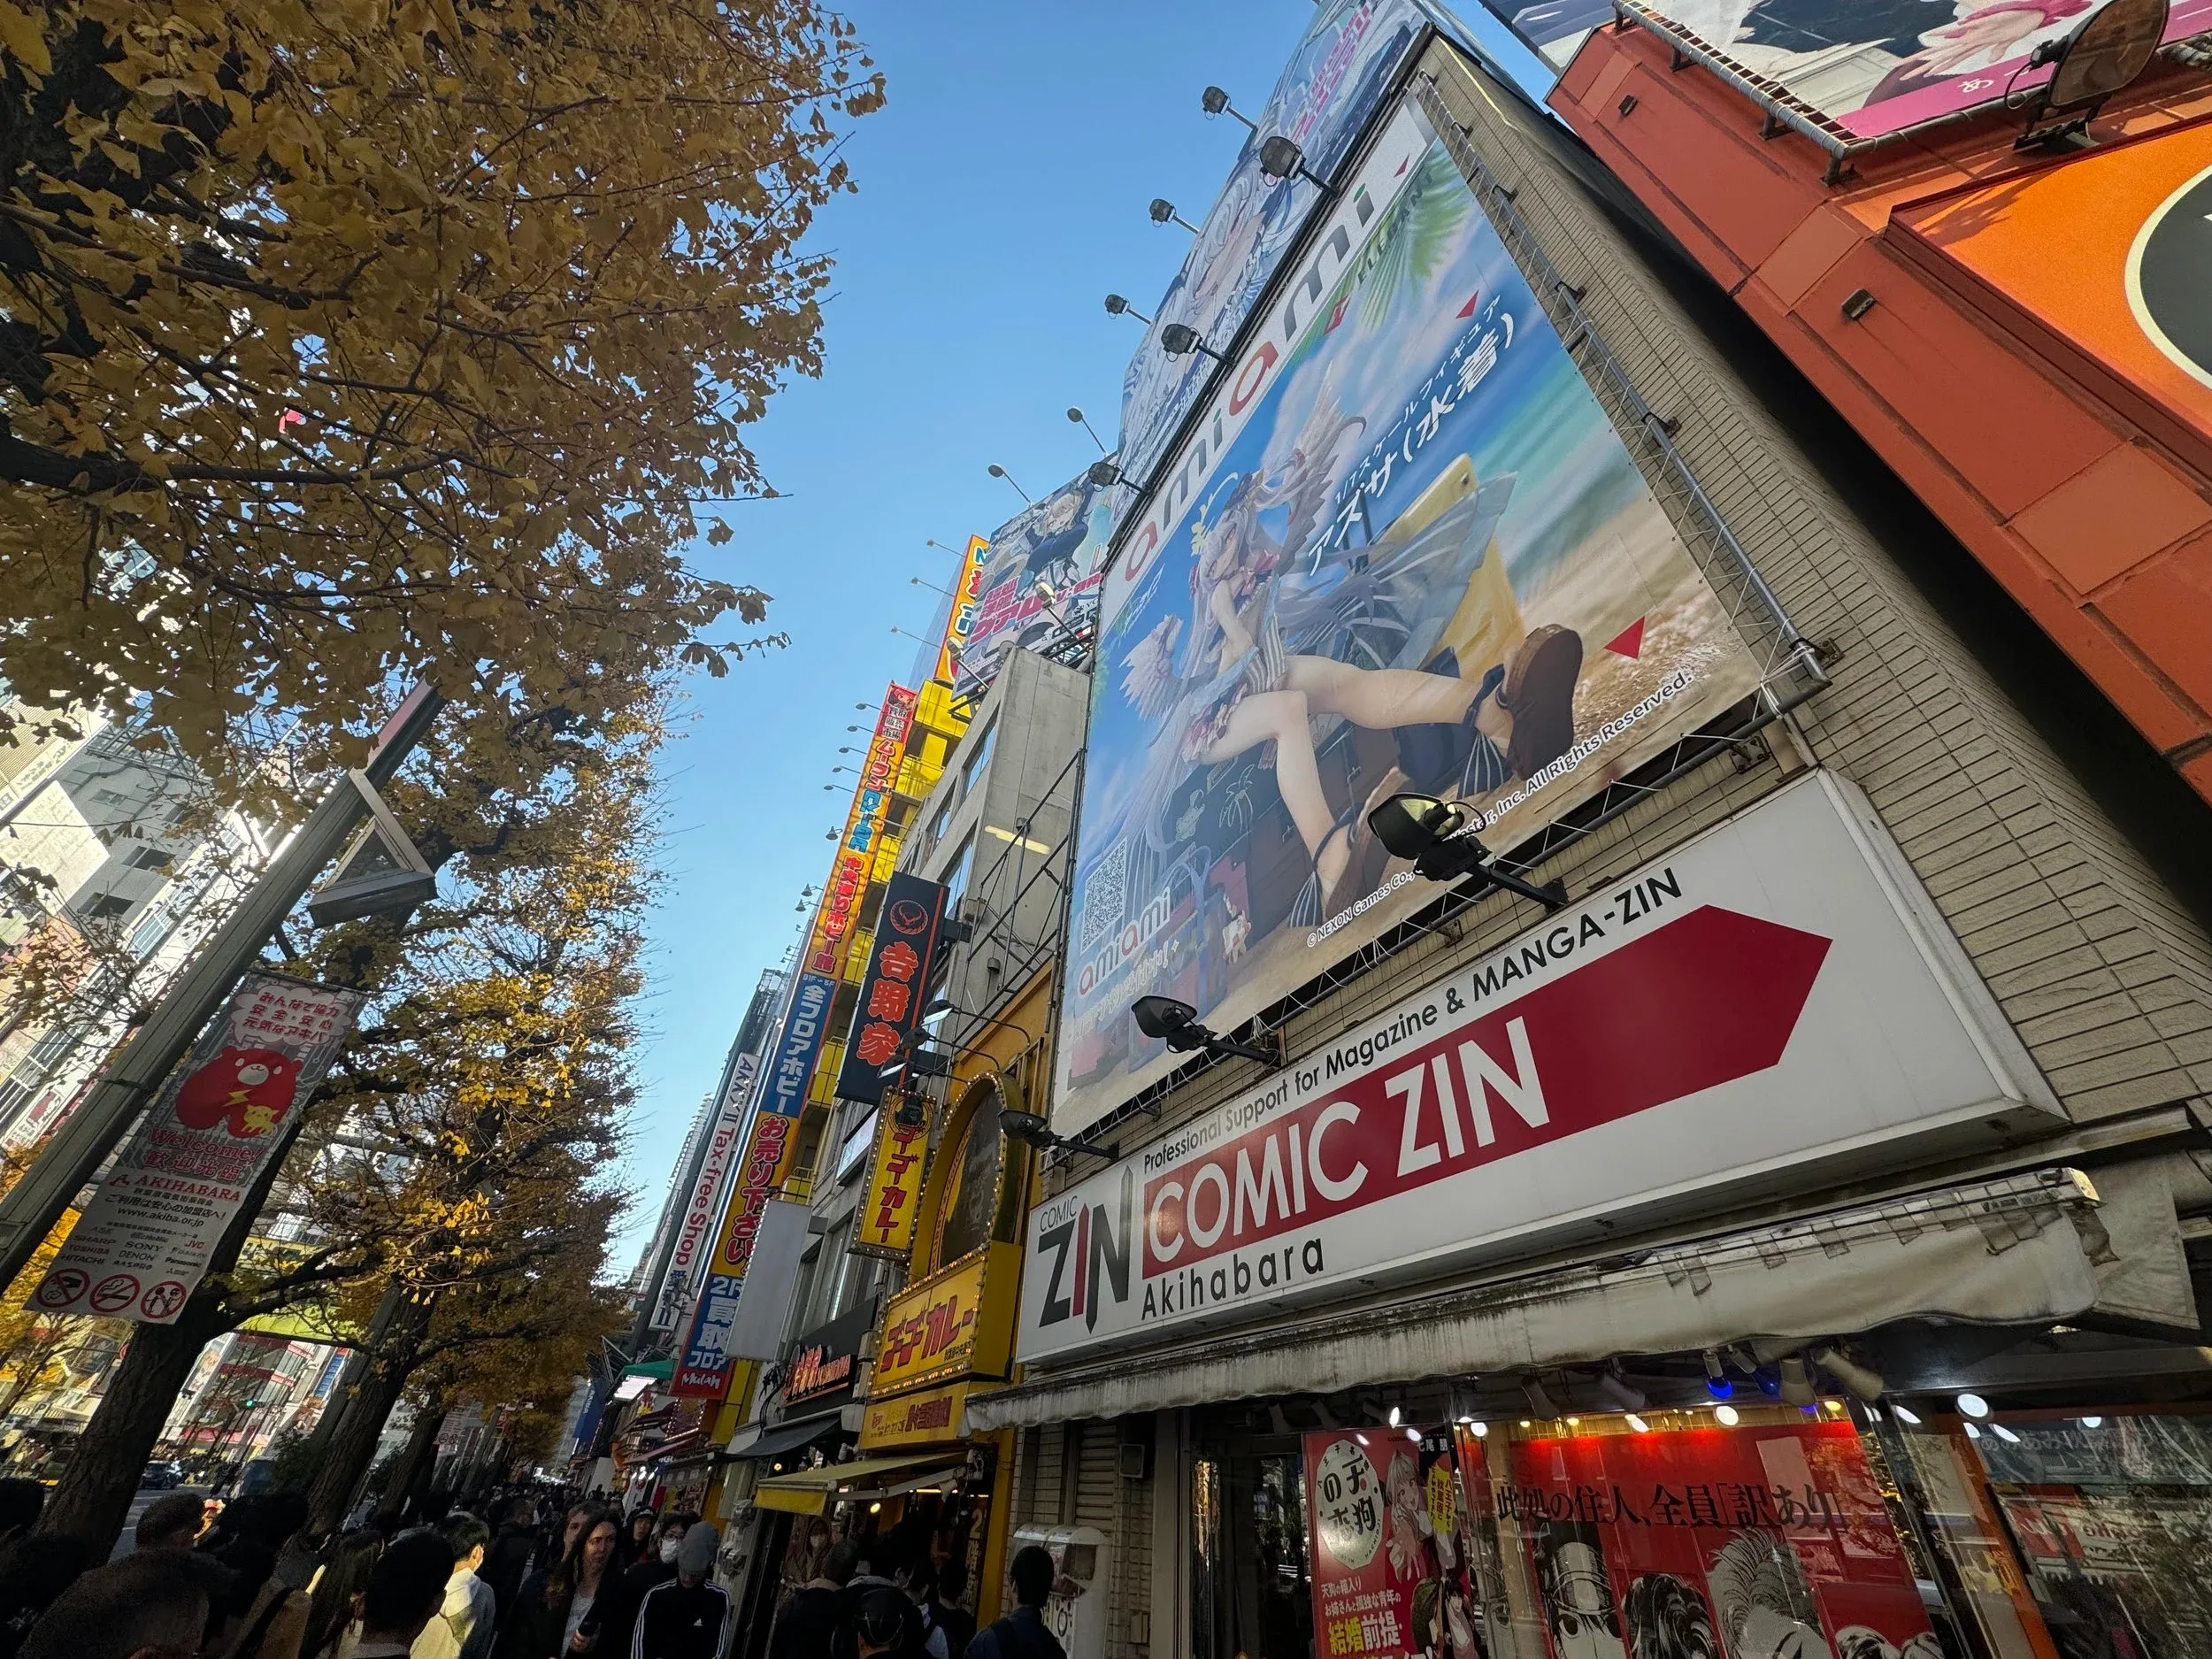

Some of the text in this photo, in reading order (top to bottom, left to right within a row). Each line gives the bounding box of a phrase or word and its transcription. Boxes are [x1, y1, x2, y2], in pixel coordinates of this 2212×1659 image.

[1125, 182, 1375, 581] amiami
[1335, 295, 1500, 504] 1/7スケールフィギュア
[1309, 312, 1514, 576] アズサ(水着)
[1316, 909, 1354, 939] NEXON
[1352, 884, 1391, 919] Games
[1497, 792, 1526, 817] Inc.
[1526, 771, 1549, 793] All
[1548, 735, 1601, 778] Rights
[1599, 672, 1693, 740] Reserved.
[1078, 886, 1171, 997] amiami
[243, 1017, 328, 1042] 元気なアキバ
[259, 992, 340, 1018] みんなで協力
[1143, 866, 1683, 1175] Professional Support for Magazine & MANGA-ZIN
[776, 984, 826, 1113] 全フロアホビー
[149, 1126, 265, 1163] Welcome!
[1149, 1101, 1369, 1263] COMIC
[1385, 1015, 1551, 1179] ZIN
[134, 1174, 241, 1202] AKIHABARA
[695, 1126, 735, 1210] Tax-free
[724, 1115, 788, 1272] お売り下さい
[875, 1124, 926, 1243] ゴーゴーカレー
[118, 1207, 205, 1228] www.akiba.or.jp
[676, 1210, 707, 1267] Shop
[1040, 1194, 1079, 1233] COMIC
[61, 1253, 106, 1265] HITACHI
[67, 1244, 111, 1256] TOSHIBA
[119, 1250, 157, 1262] DENON
[124, 1241, 164, 1252] SONY
[184, 1240, 205, 1249] JVC
[1038, 1164, 1133, 1334] ZIN
[1141, 1238, 1325, 1321] Akihabara
[697, 1297, 738, 1352] 買取
[681, 1371, 722, 1390] Mulan
[687, 1351, 729, 1371] フロア
[1328, 1610, 1401, 1655] 結婚前提
